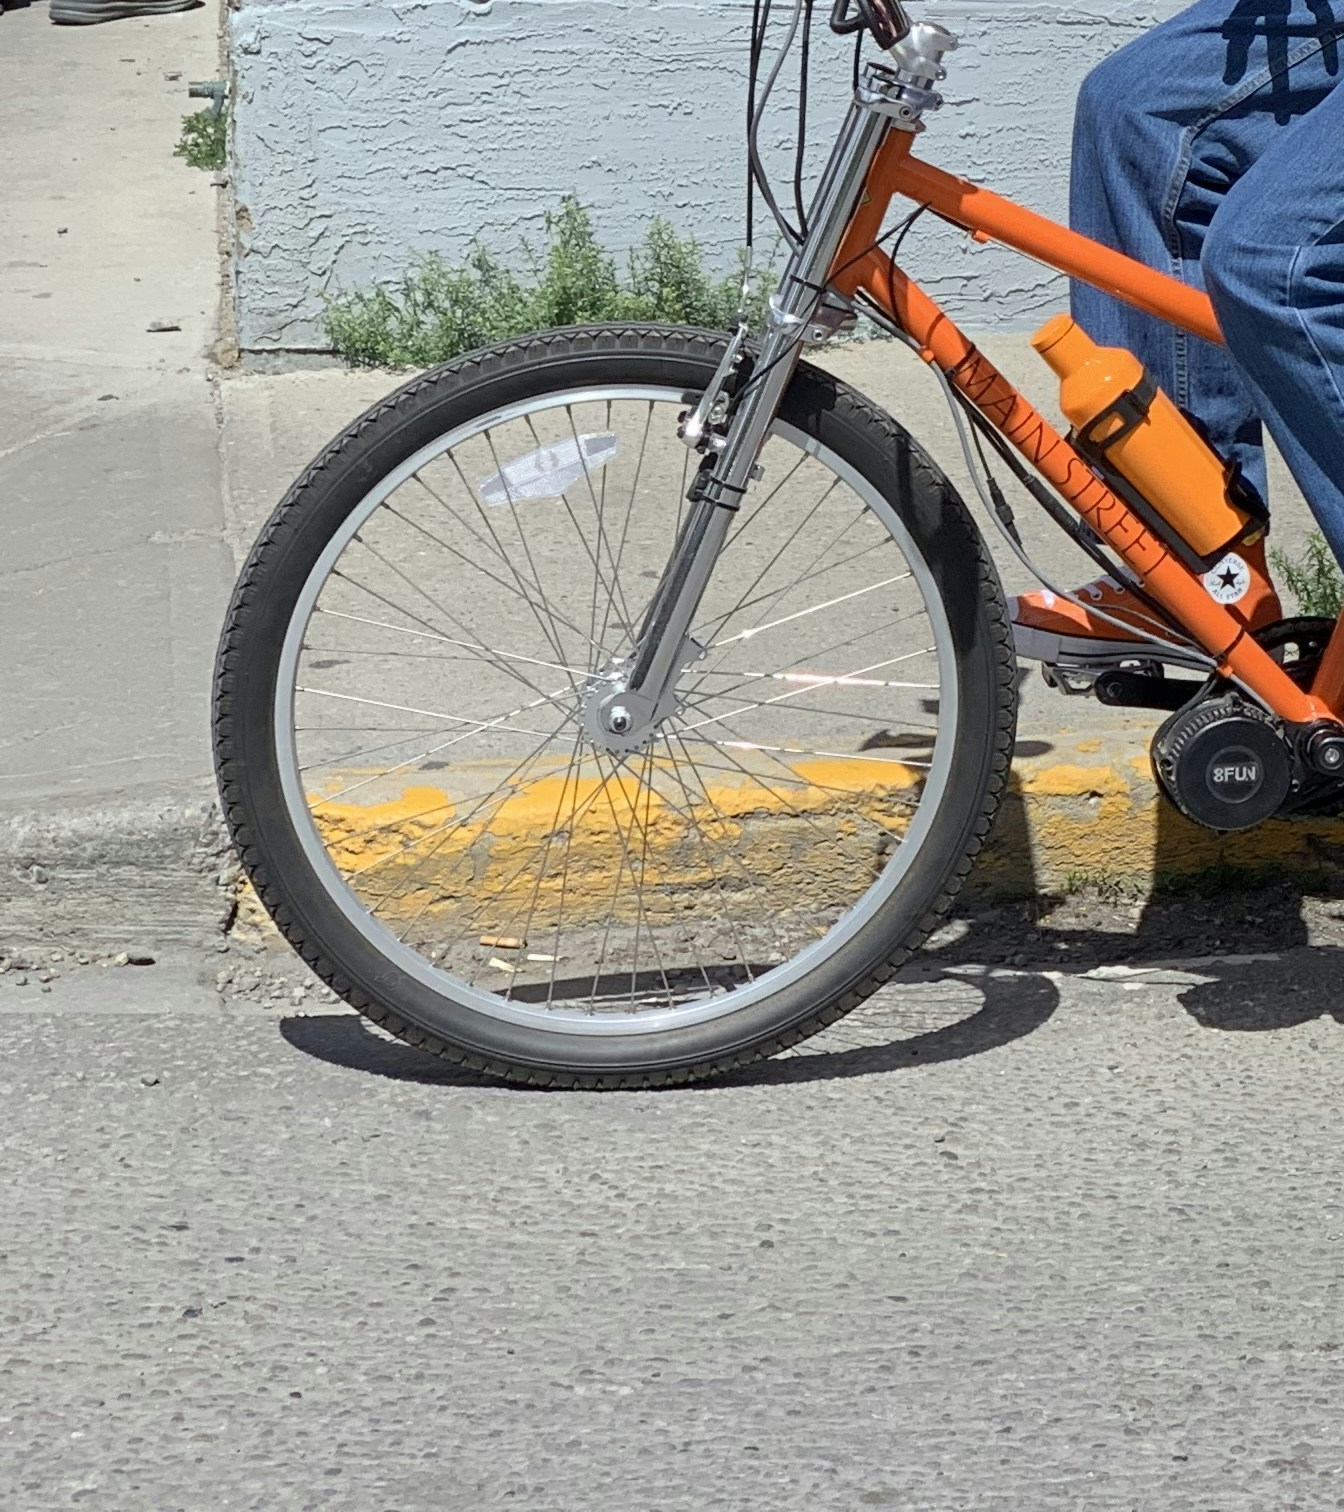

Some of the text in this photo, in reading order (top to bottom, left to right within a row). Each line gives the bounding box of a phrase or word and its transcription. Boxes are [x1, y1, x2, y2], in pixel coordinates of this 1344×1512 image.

[956, 356, 1169, 577] MAIN STREET
[1213, 766, 1257, 783] 8FUN
